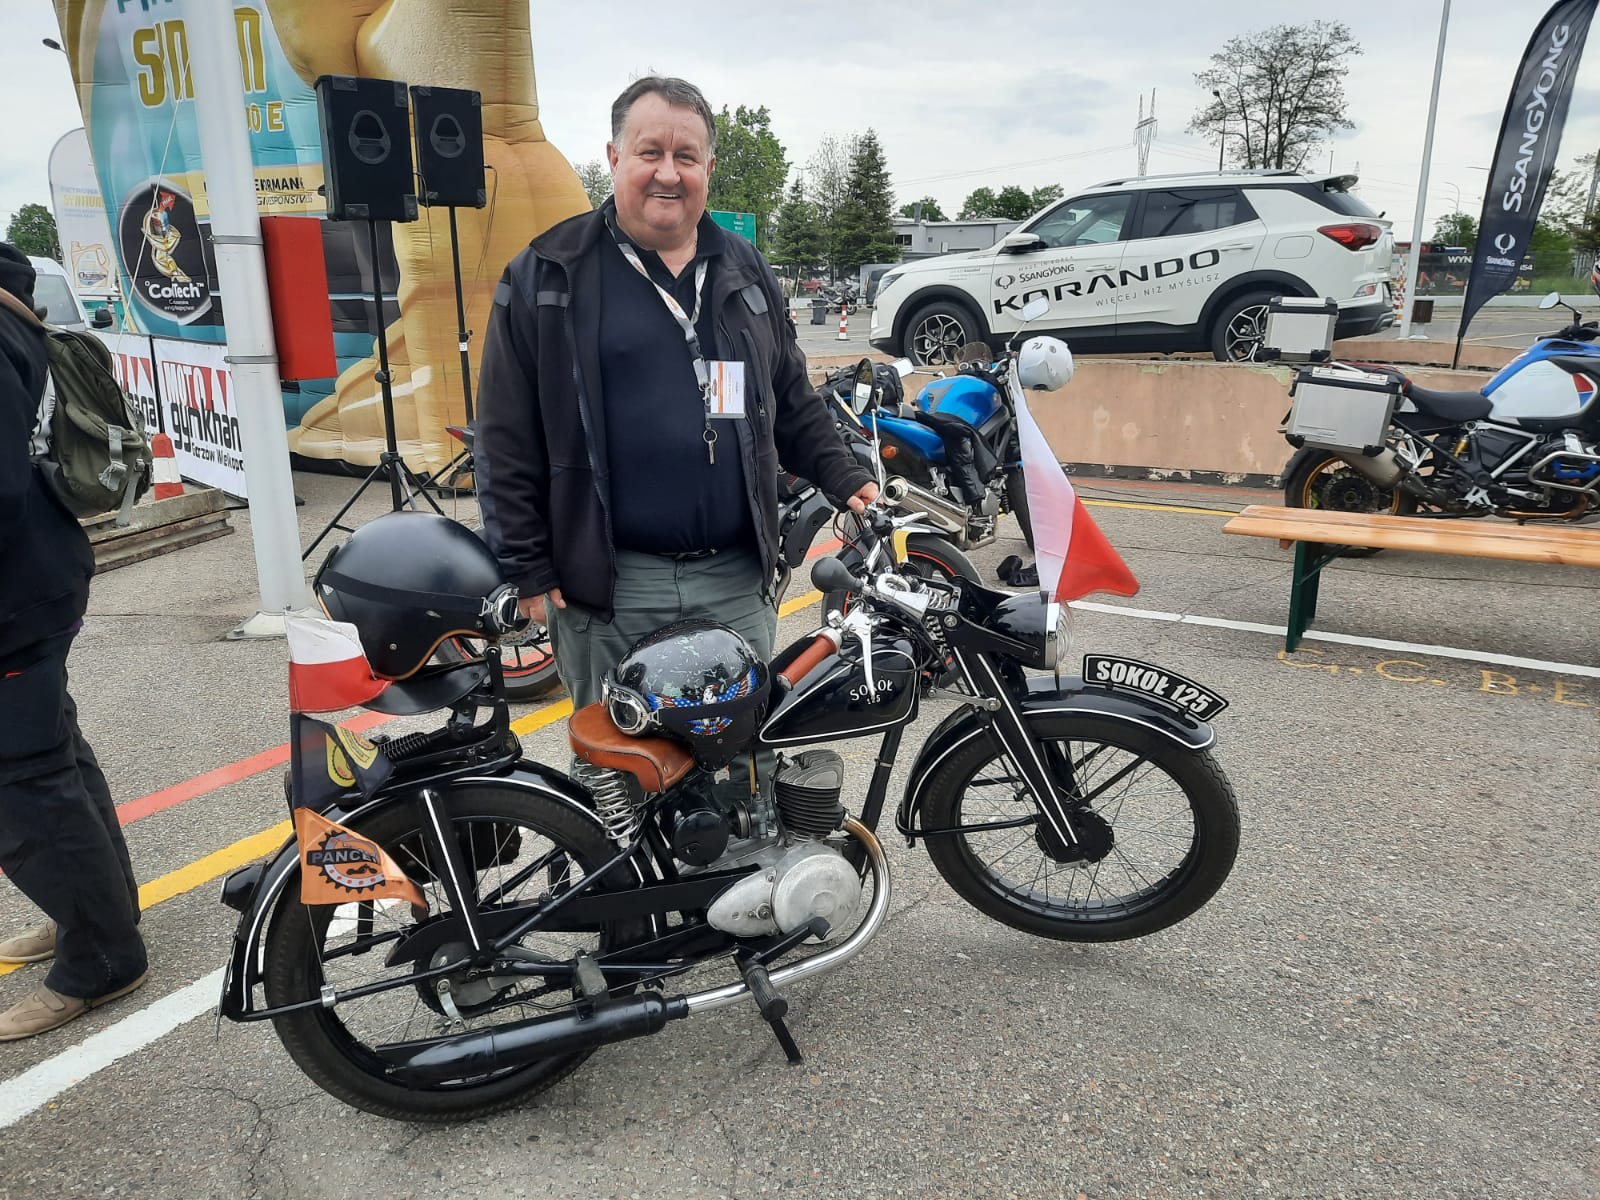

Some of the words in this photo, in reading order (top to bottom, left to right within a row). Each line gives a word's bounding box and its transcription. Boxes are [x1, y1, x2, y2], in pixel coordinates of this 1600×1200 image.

[1503, 24, 1570, 213] SSANGYONG
[994, 249, 1220, 315] KORANDO
[1019, 263, 1075, 284] SSANGYONG
[1448, 255, 1473, 264] WYN
[170, 397, 243, 453] gymkhan
[849, 679, 894, 701] SOOŁ
[1096, 660, 1170, 696] SOKOŁ
[1169, 684, 1213, 713] 125
